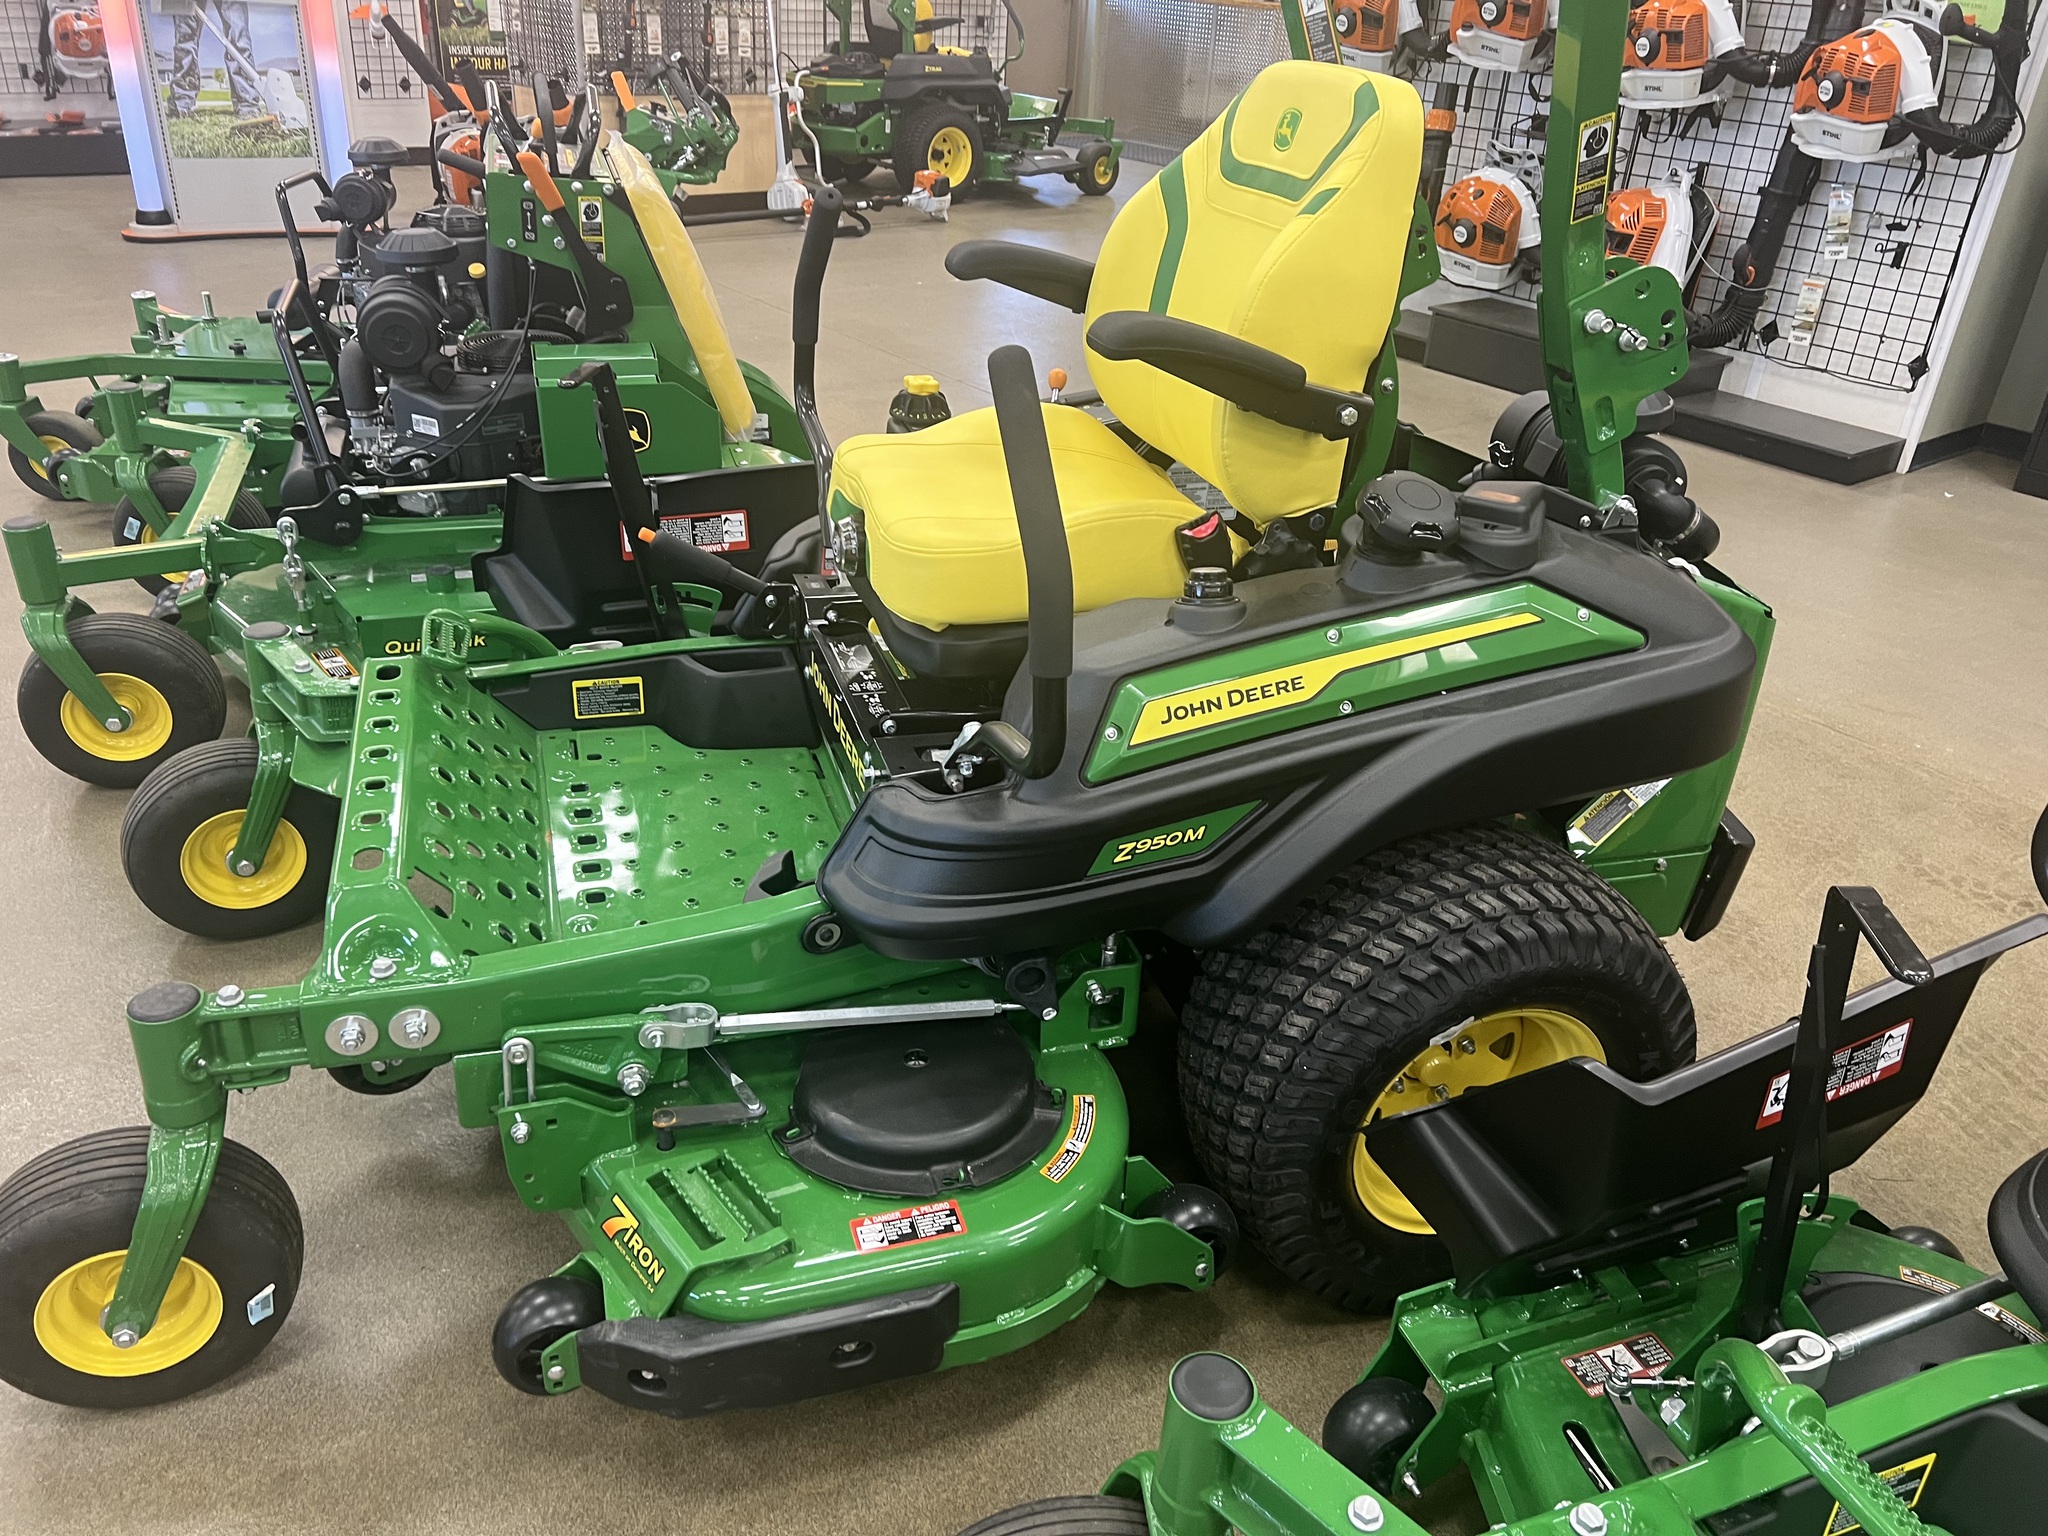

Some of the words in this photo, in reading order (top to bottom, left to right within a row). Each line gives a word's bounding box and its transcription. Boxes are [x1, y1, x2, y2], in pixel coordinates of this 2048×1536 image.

[448, 45, 472, 56] INSIDE
[1481, 44, 1500, 54] STIHL
[1588, 114, 1613, 127] CAUTION
[1822, 129, 1841, 140] STIHL
[1453, 260, 1472, 271] STIHL
[597, 680, 620, 688] CAUTION
[1161, 696, 1222, 725] JOHN
[1227, 675, 1305, 707] DEERE
[809, 651, 832, 718] JOHN
[833, 697, 865, 792] DEERE
[1588, 792, 1615, 818] ATENCIÓN
[1113, 825, 1206, 864] Z950M
[1838, 1076, 1872, 1097] DANGER
[919, 1201, 951, 1215] PELIGRO
[872, 1211, 902, 1223] DANGER
